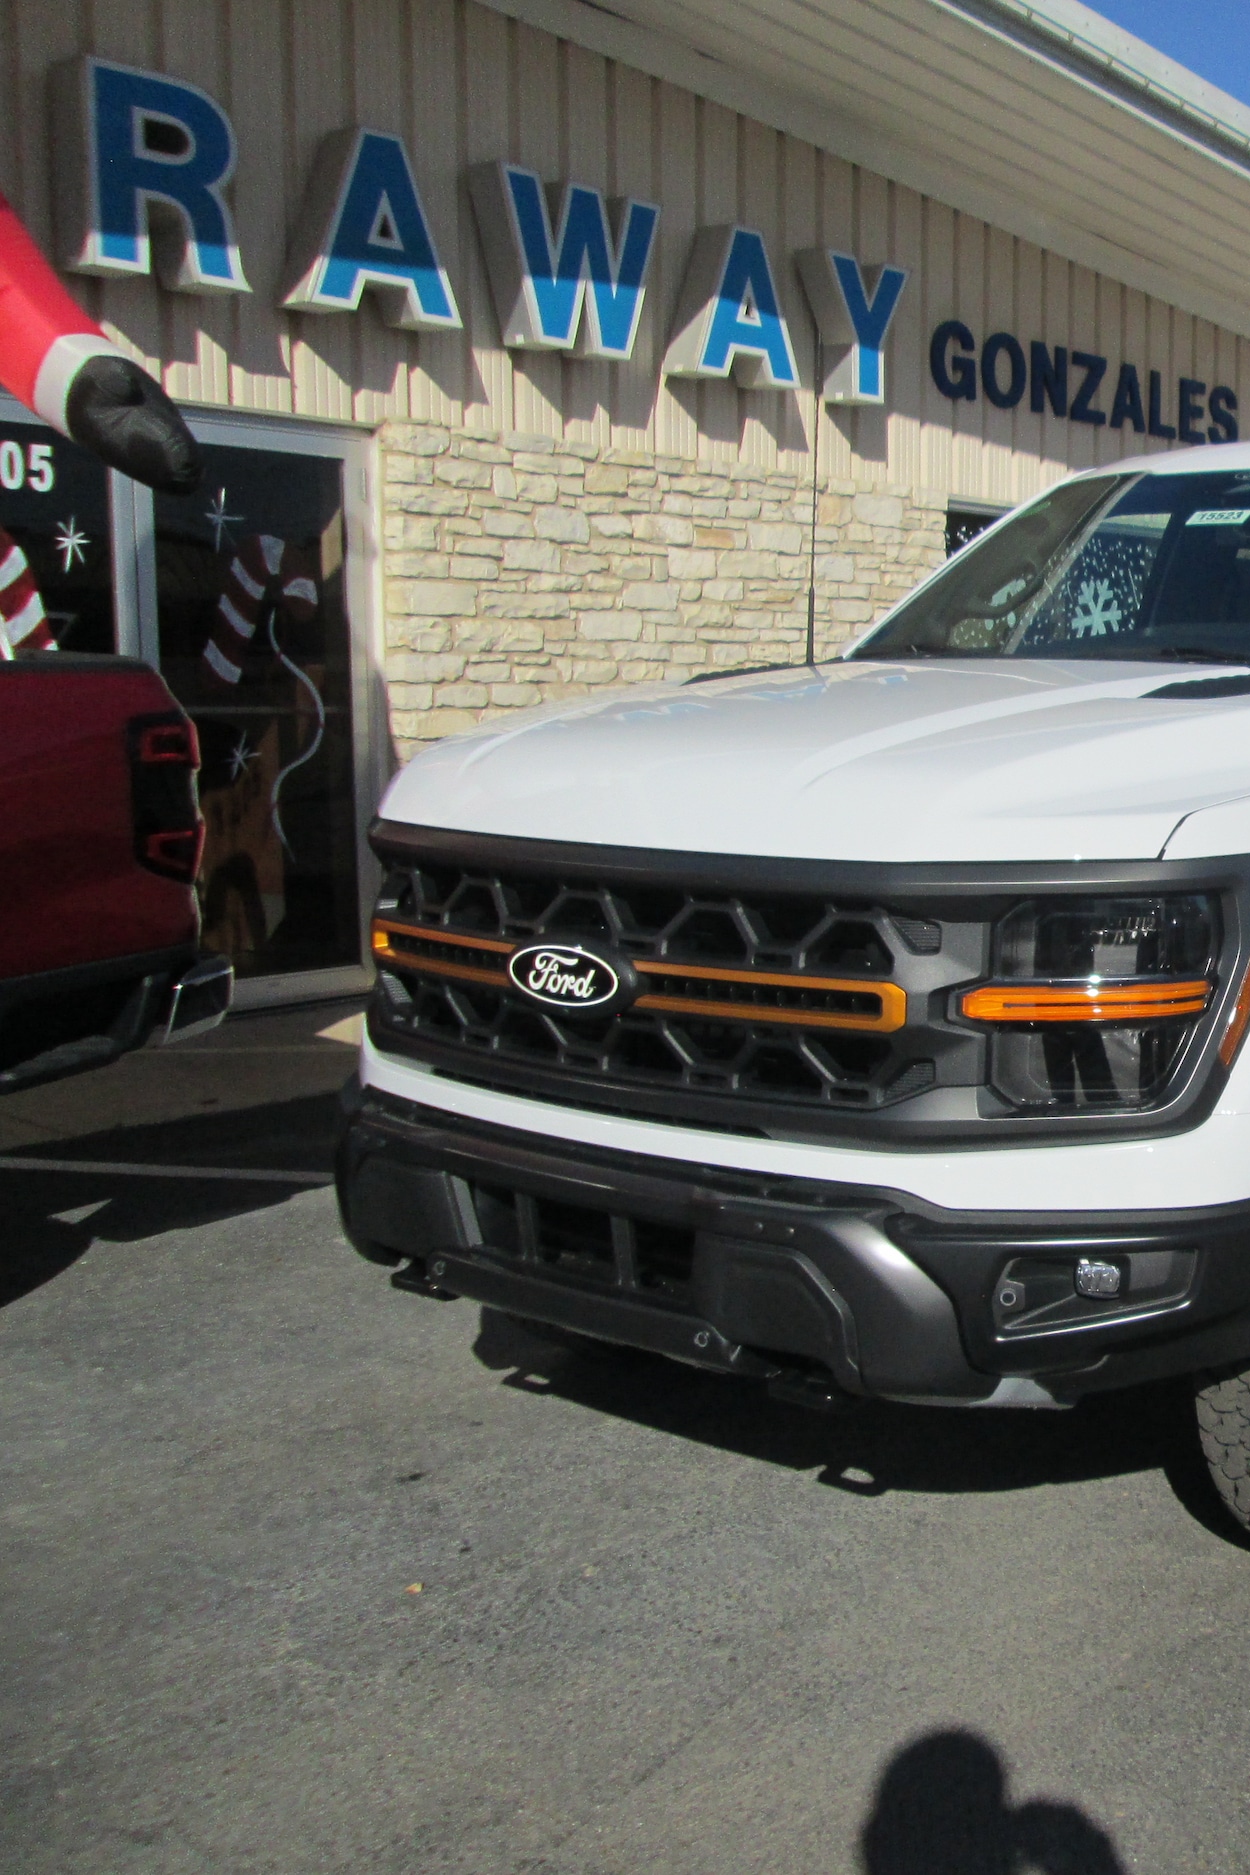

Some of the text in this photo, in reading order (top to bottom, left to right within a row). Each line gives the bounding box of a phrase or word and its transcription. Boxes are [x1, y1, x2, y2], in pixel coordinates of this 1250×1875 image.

[84, 55, 1239, 445] RAWAY GONZALES
[0, 440, 55, 492] 05
[1199, 510, 1245, 521] 15523
[528, 952, 597, 998] Ford
